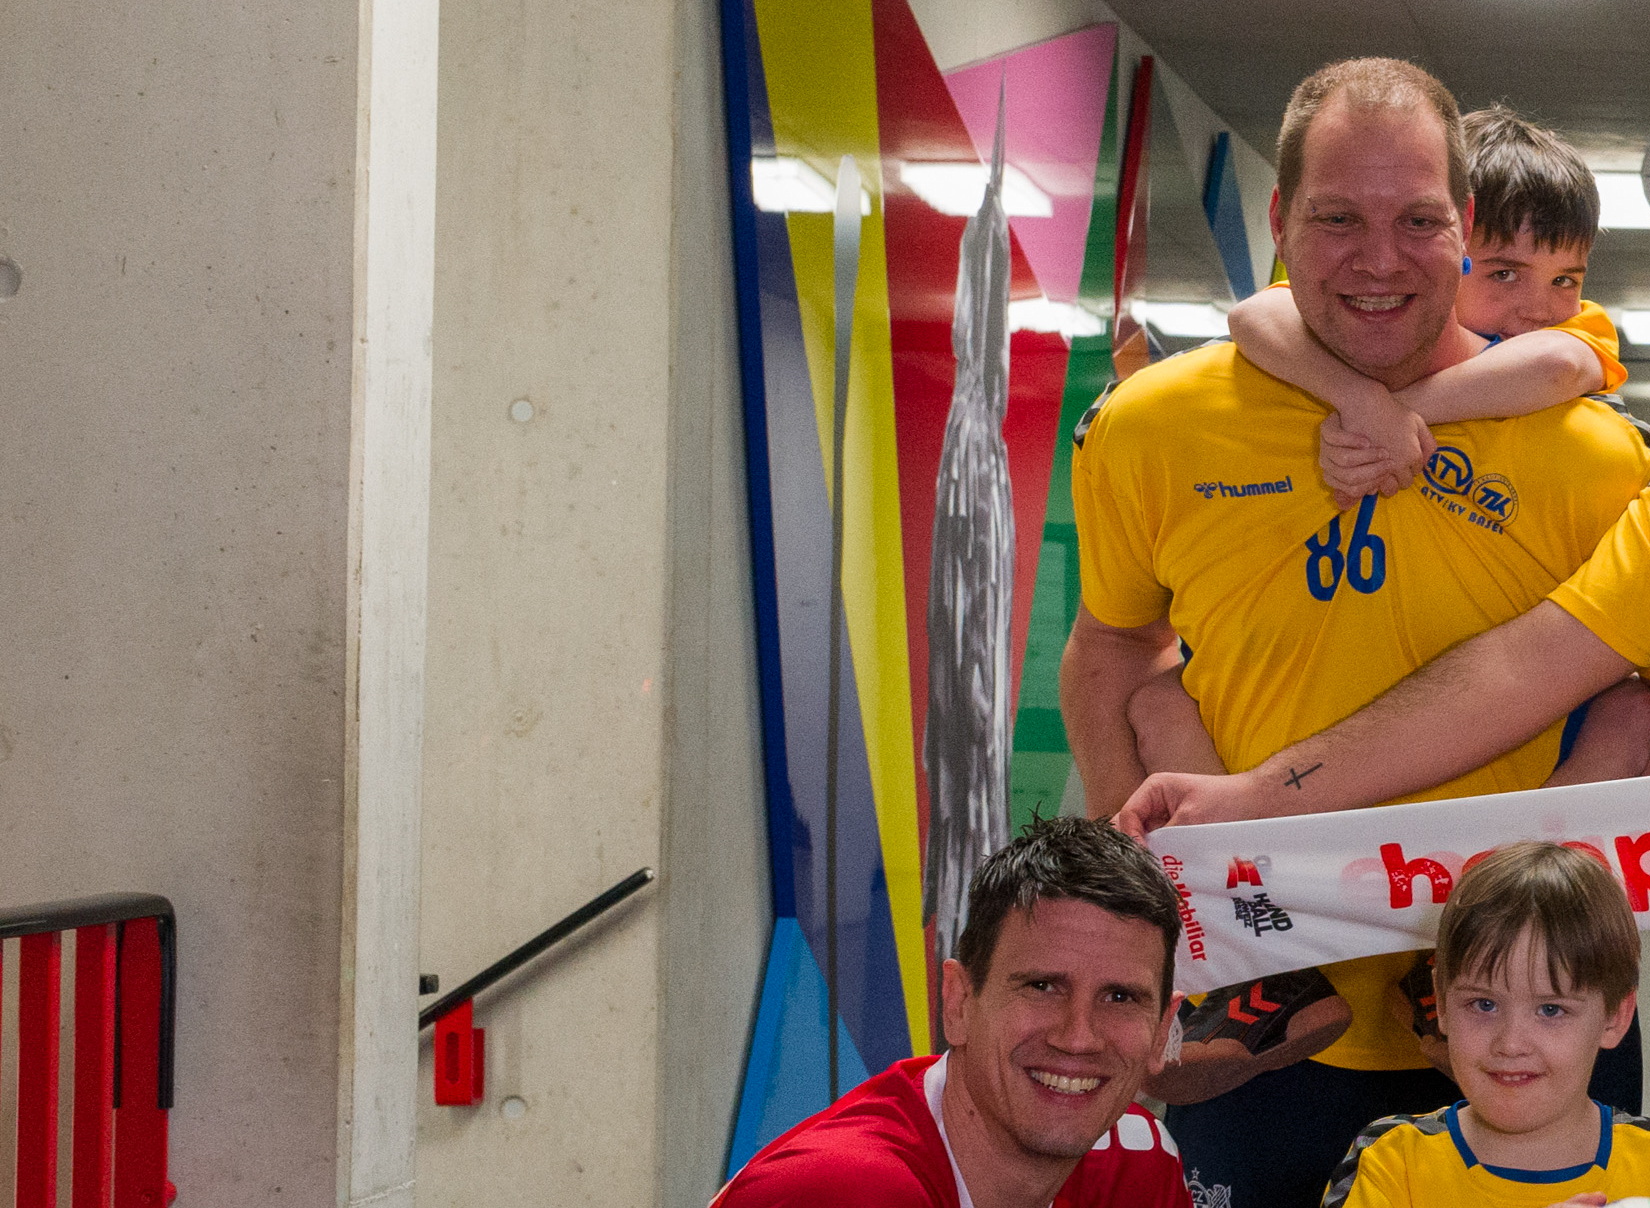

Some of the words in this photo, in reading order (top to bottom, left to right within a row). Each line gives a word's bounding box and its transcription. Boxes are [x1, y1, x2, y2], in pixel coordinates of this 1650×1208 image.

[1218, 475, 1294, 498] hummel
[1304, 491, 1386, 602] 86
[1161, 855, 1183, 882] die
